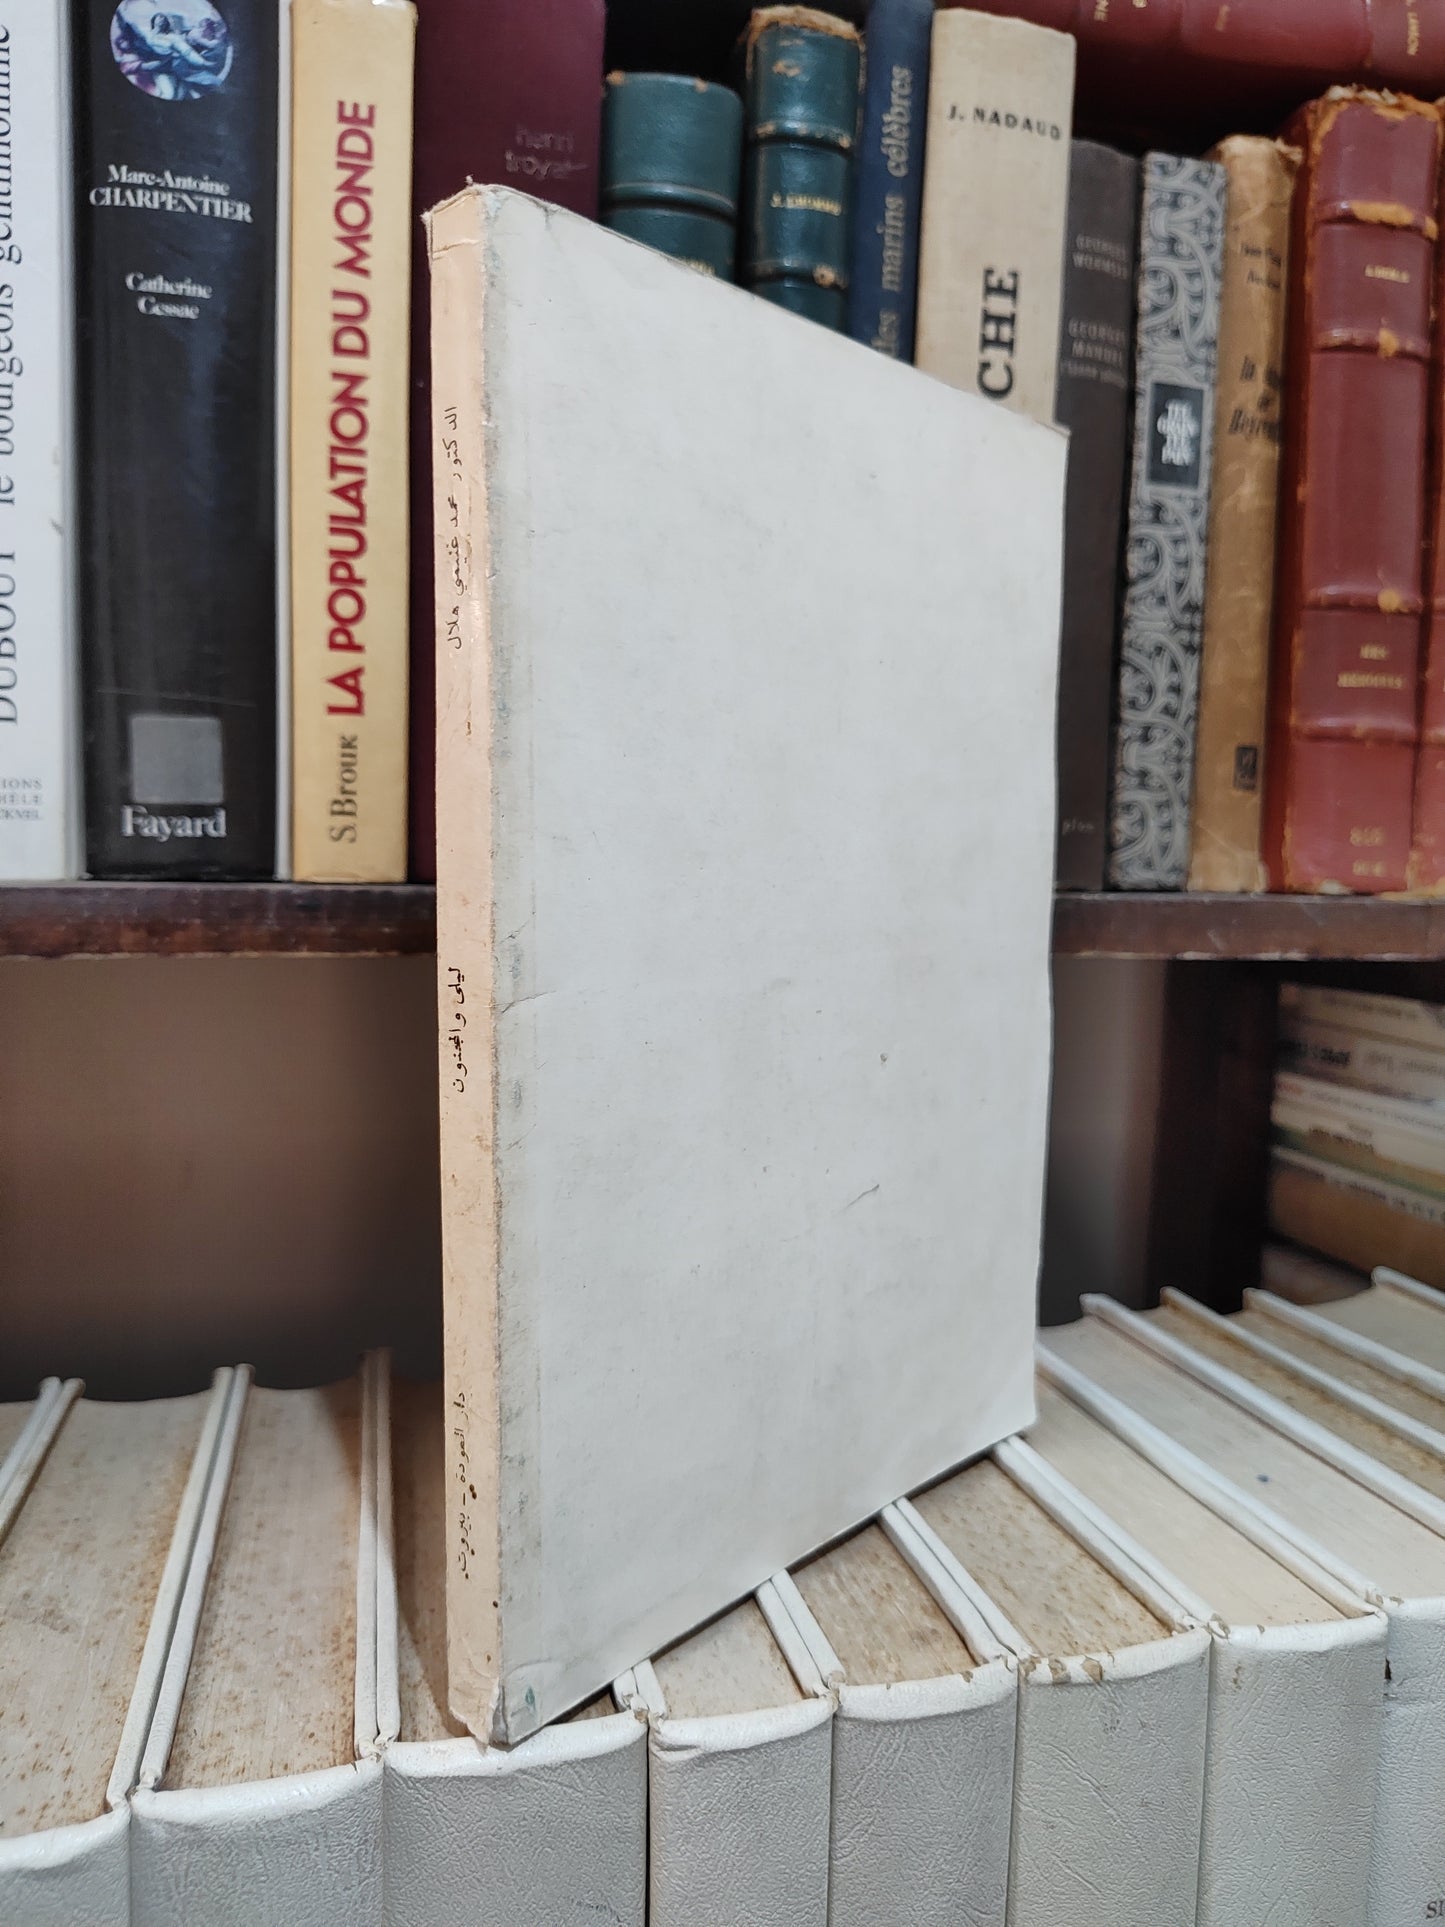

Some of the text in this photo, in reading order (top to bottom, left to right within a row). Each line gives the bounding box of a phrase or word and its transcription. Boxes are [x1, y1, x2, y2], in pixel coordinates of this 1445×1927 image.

[947, 105, 1062, 141] J. NADAUD
[107, 164, 231, 196] Marc-Antoine
[89, 186, 254, 224] CHARPENTIER
[125, 271, 213, 299] Catherine
[326, 100, 376, 717] LA POPULATION DU MONDE
[122, 804, 228, 842] Fayard
